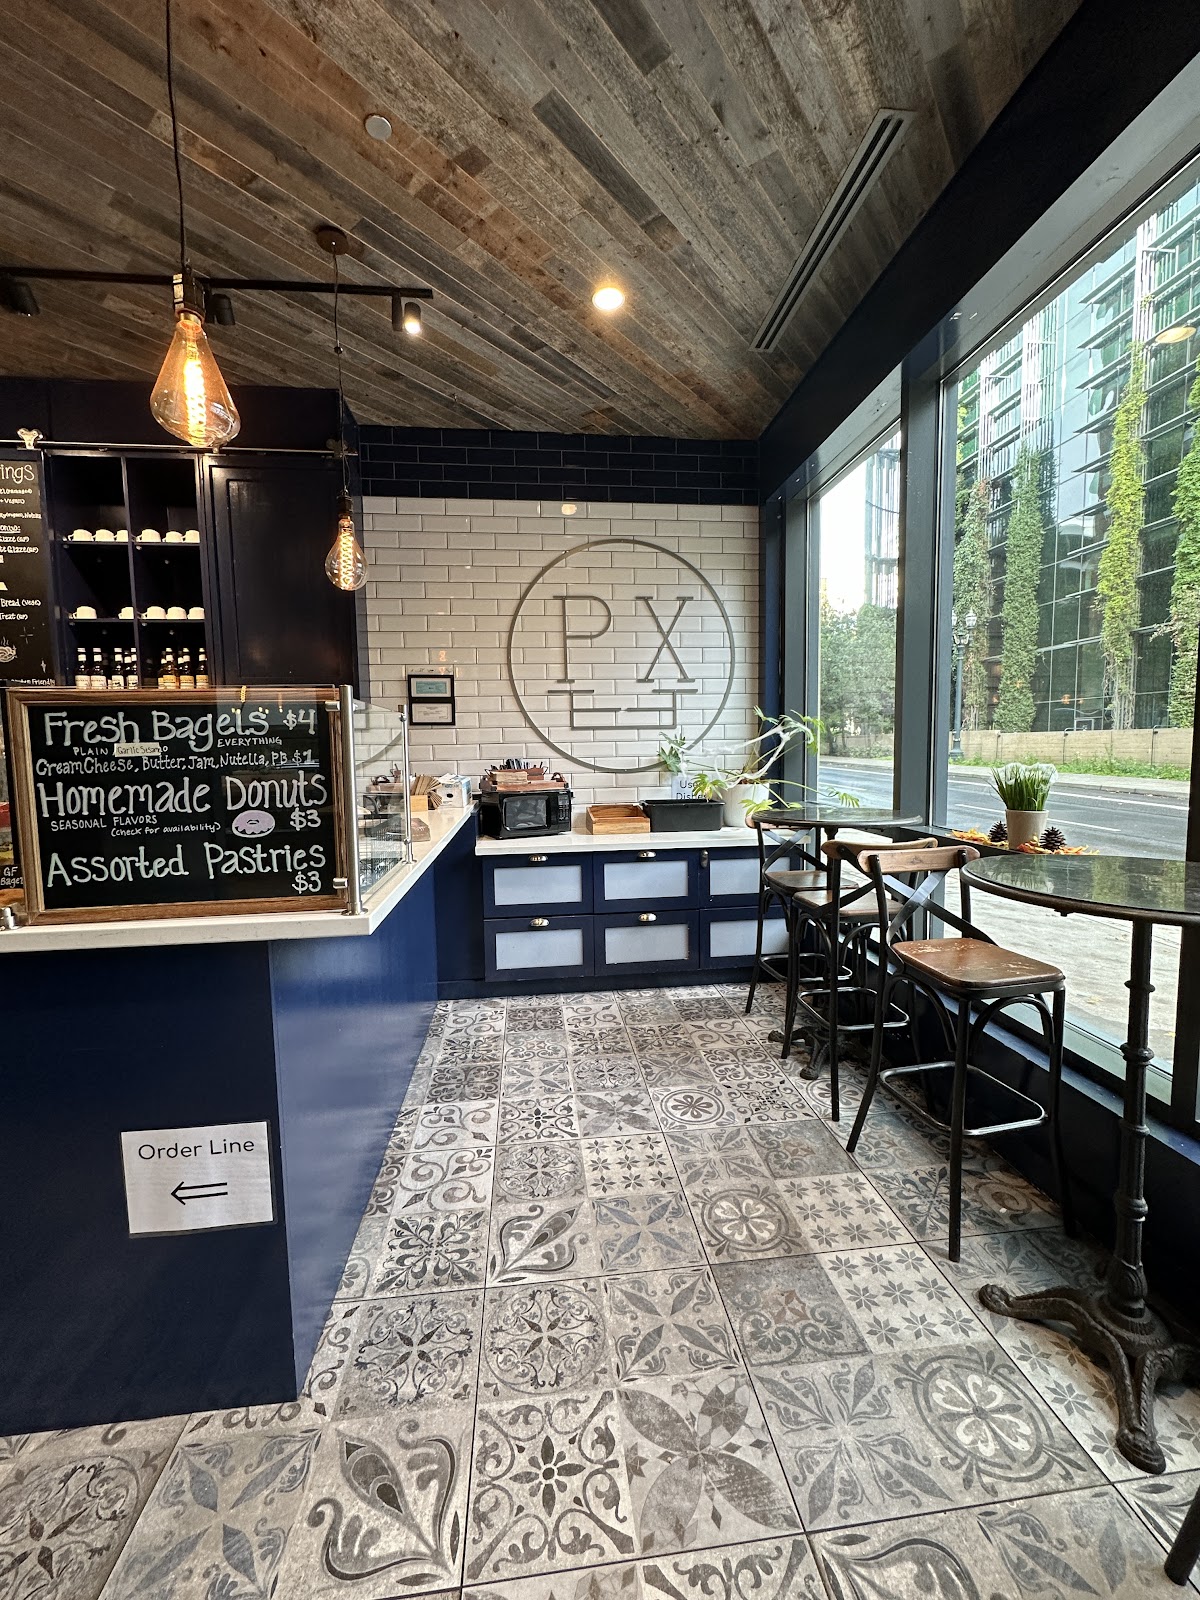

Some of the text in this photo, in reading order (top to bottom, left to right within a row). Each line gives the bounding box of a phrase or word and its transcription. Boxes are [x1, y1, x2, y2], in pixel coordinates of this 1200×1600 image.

[0, 464, 35, 485] ings
[44, 708, 316, 752] Fresh Bagels $4
[73, 746, 109, 756] PLAIN
[217, 737, 282, 748] EVERYTHING
[271, 751, 287, 766] PB
[292, 749, 316, 766] $1
[37, 770, 327, 818] Homemade Donuts
[50, 815, 158, 832] SEASONAL FLAVORS
[290, 807, 321, 831] $3
[144, 826, 161, 835] for
[3, 867, 19, 877] GF
[47, 842, 326, 888] Assorted Pastries
[292, 871, 322, 894] $3
[138, 1139, 255, 1160] Order Line
